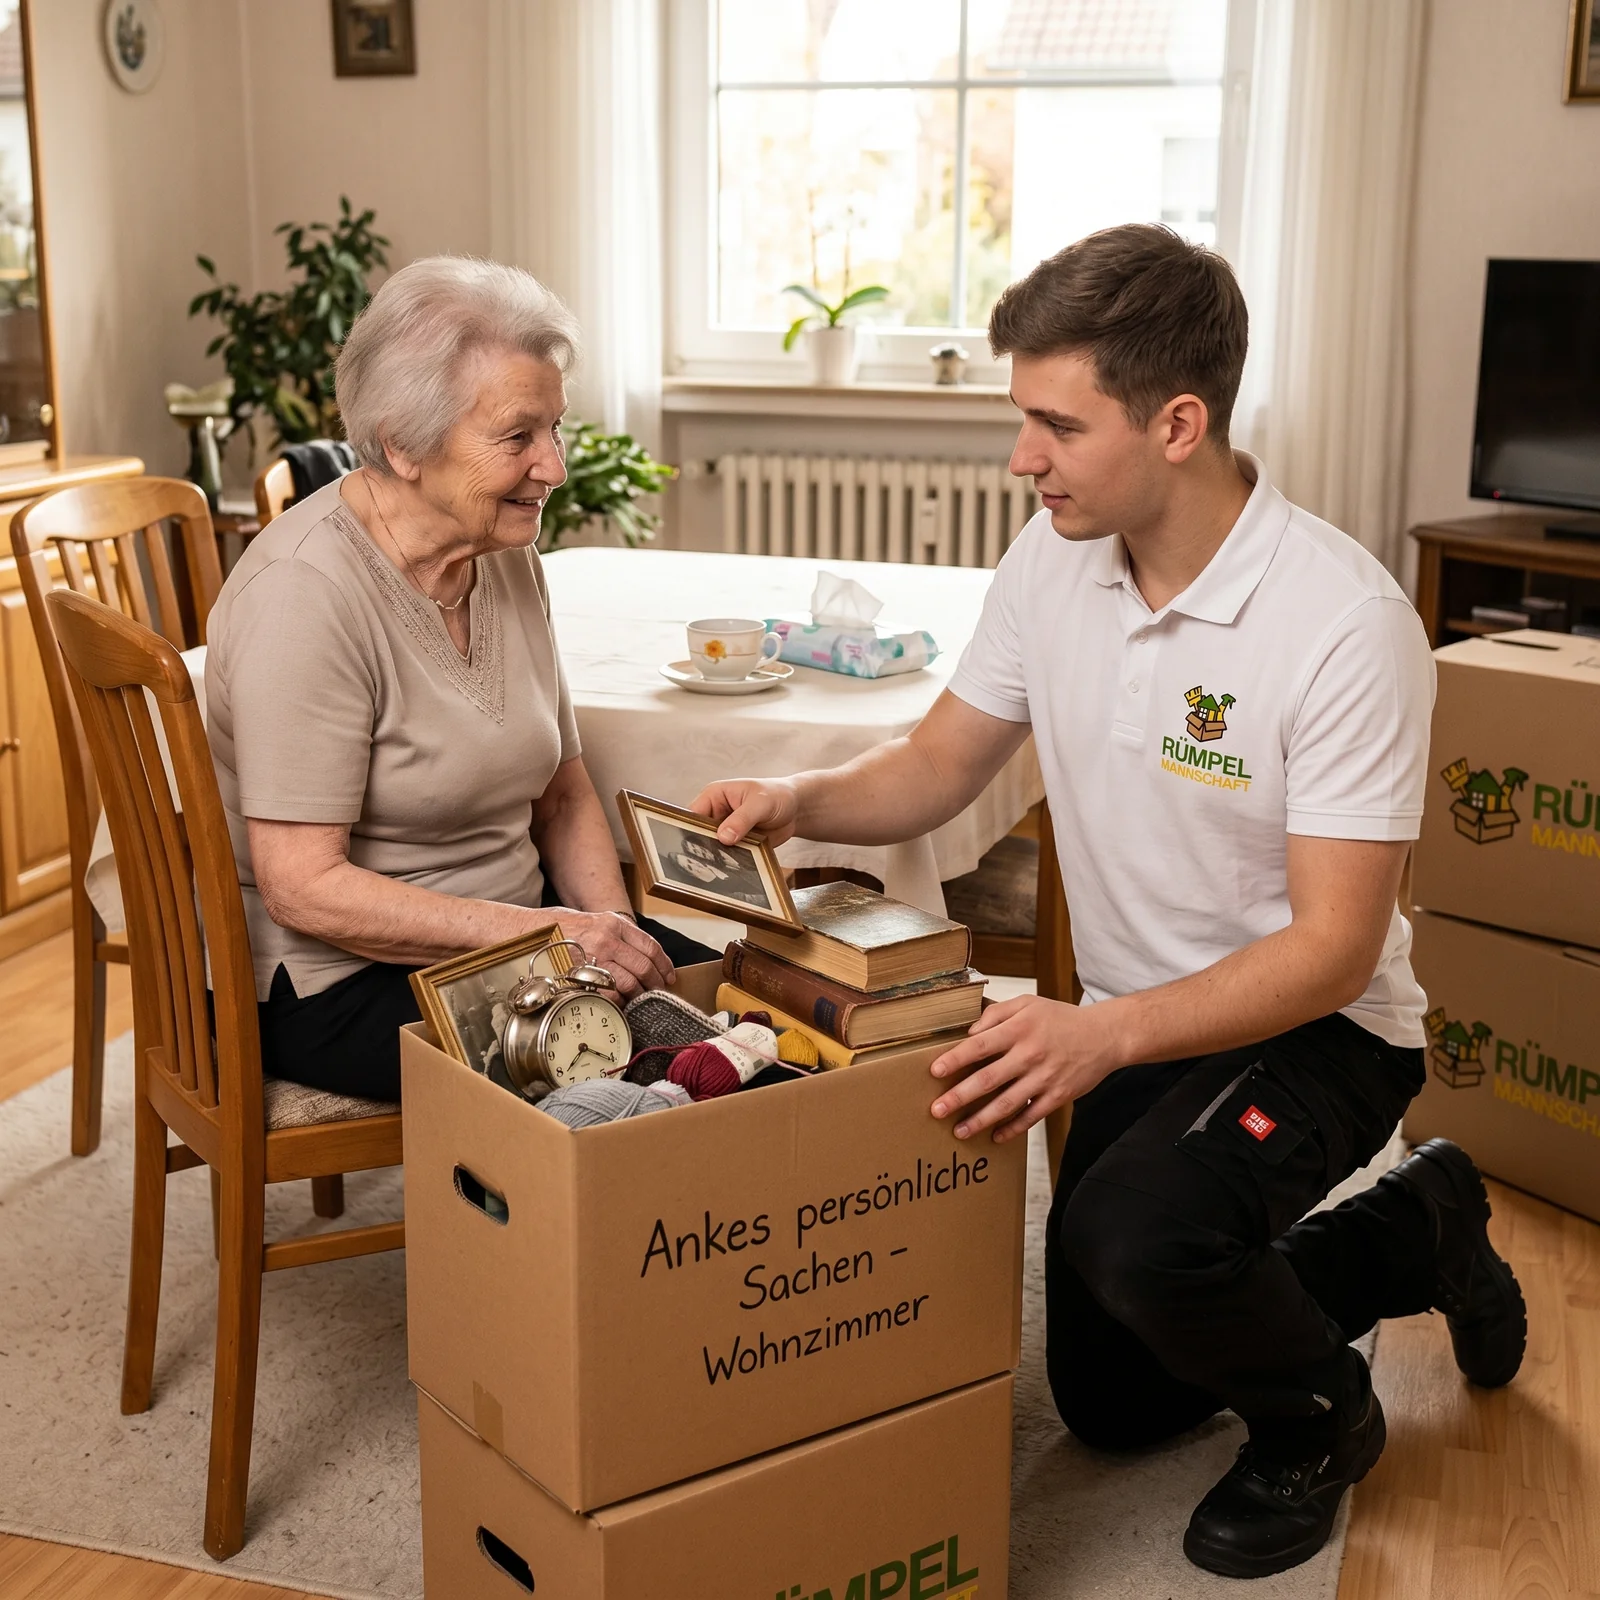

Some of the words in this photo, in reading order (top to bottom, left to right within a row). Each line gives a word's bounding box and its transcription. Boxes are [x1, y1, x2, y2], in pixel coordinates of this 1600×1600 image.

[1161, 757, 1252, 792] MANNSCHAFT
[1162, 735, 1252, 779] RÜMPEL
[1533, 780, 1600, 832] RÜ
[558, 1016, 566, 1026] 11
[570, 1006, 581, 1016] 12
[601, 1017, 608, 1027] 2
[550, 1032, 559, 1043] 10
[548, 1051, 555, 1061] 9
[556, 1067, 563, 1077] 8
[1493, 1075, 1600, 1139] MANNSCH
[640, 1210, 771, 1278] Ankes
[797, 1151, 990, 1249] persönliche
[739, 1250, 873, 1310] Sachen
[703, 1294, 930, 1386] Wohnzimmer
